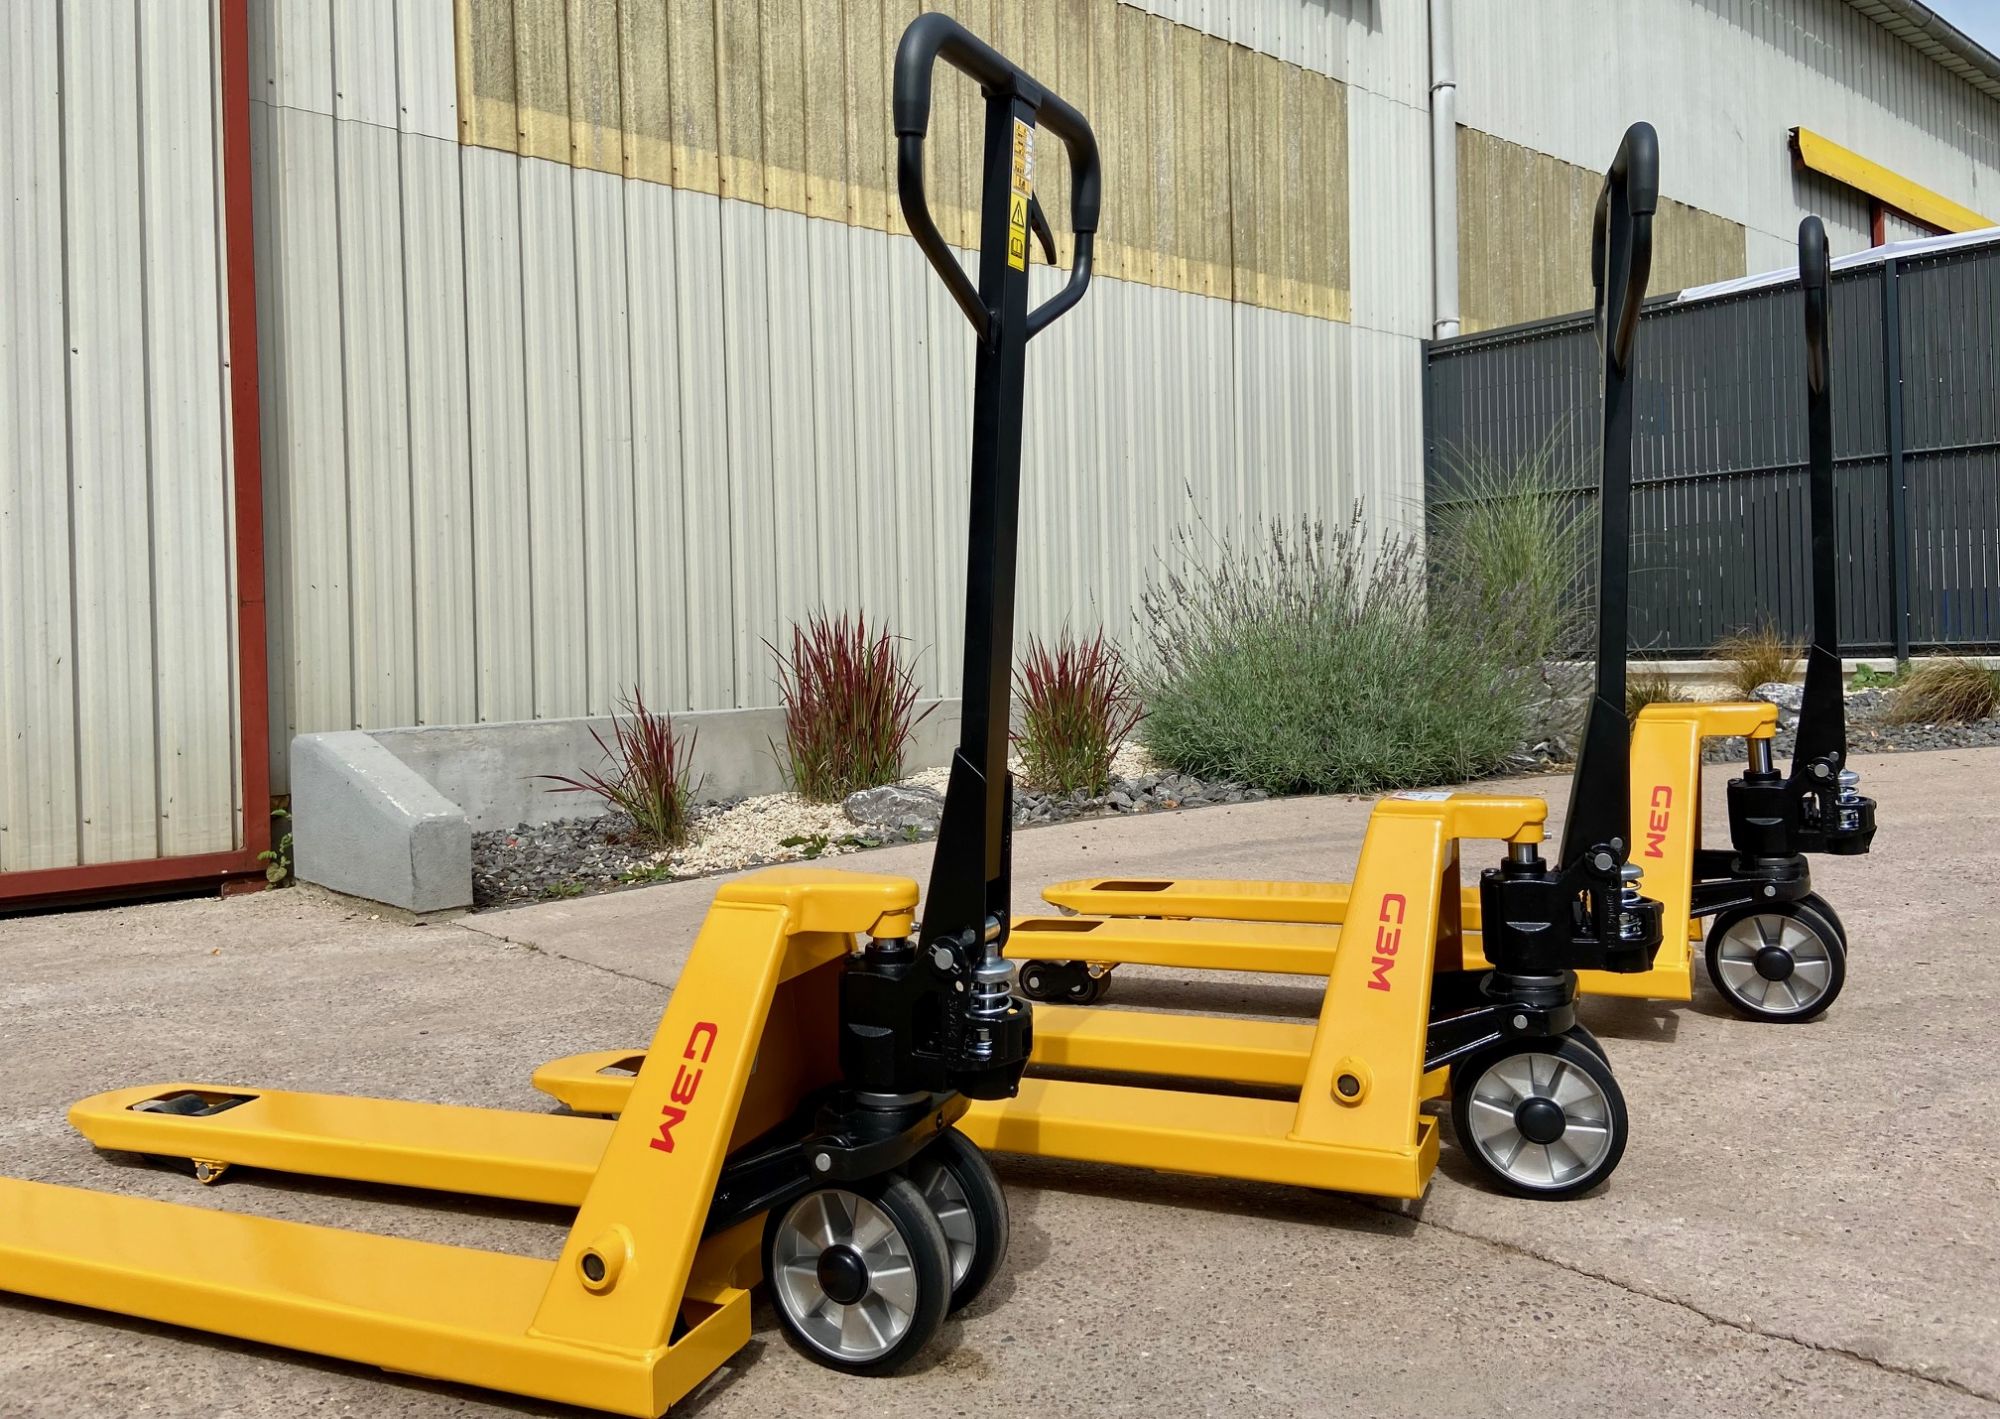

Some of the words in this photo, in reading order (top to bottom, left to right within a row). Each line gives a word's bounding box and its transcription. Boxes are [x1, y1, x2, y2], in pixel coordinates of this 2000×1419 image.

[1645, 786, 1672, 858] G3M
[1368, 894, 1406, 992] G3M
[650, 1022, 718, 1153] G3M
